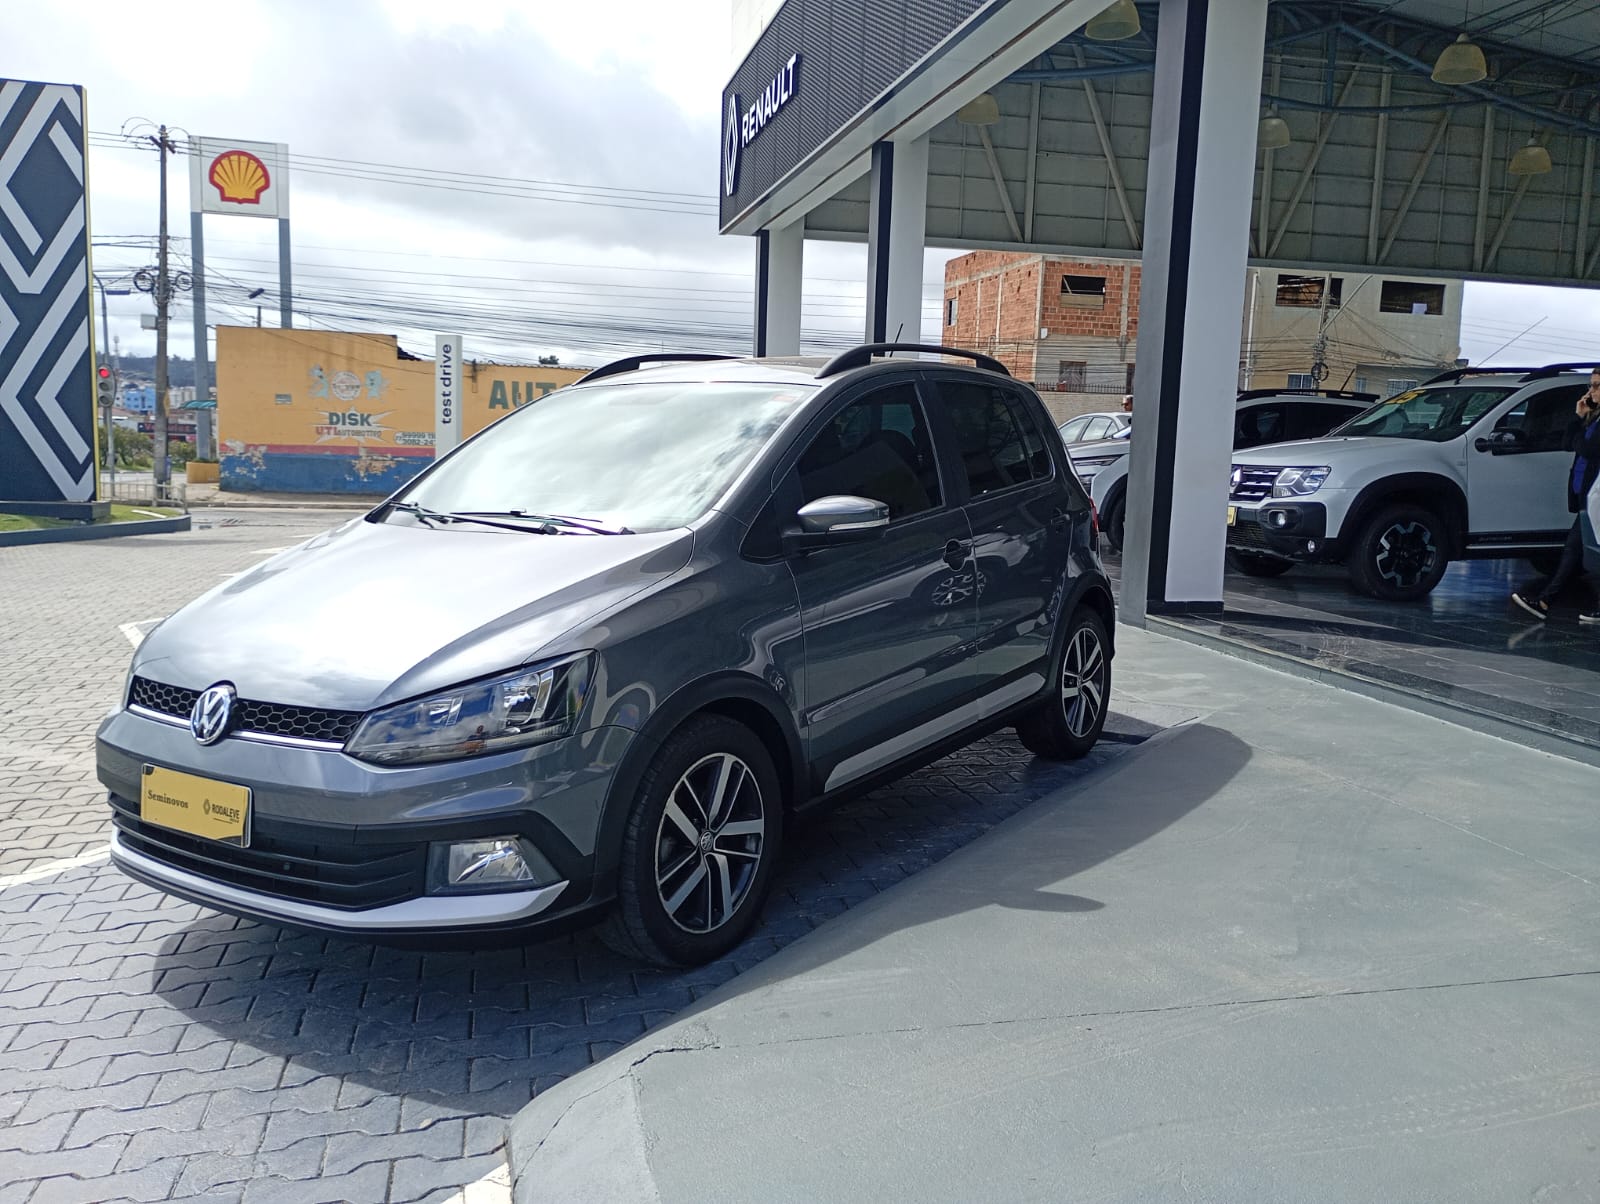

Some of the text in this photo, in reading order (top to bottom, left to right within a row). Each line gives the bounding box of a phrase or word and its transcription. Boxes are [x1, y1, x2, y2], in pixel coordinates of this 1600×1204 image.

[742, 53, 797, 148] RENAULT
[440, 344, 452, 424] test drive
[488, 380, 572, 409] AUT
[328, 412, 372, 426] DISK
[147, 790, 189, 808] Seminovos
[212, 804, 240, 819] RODALEVE
